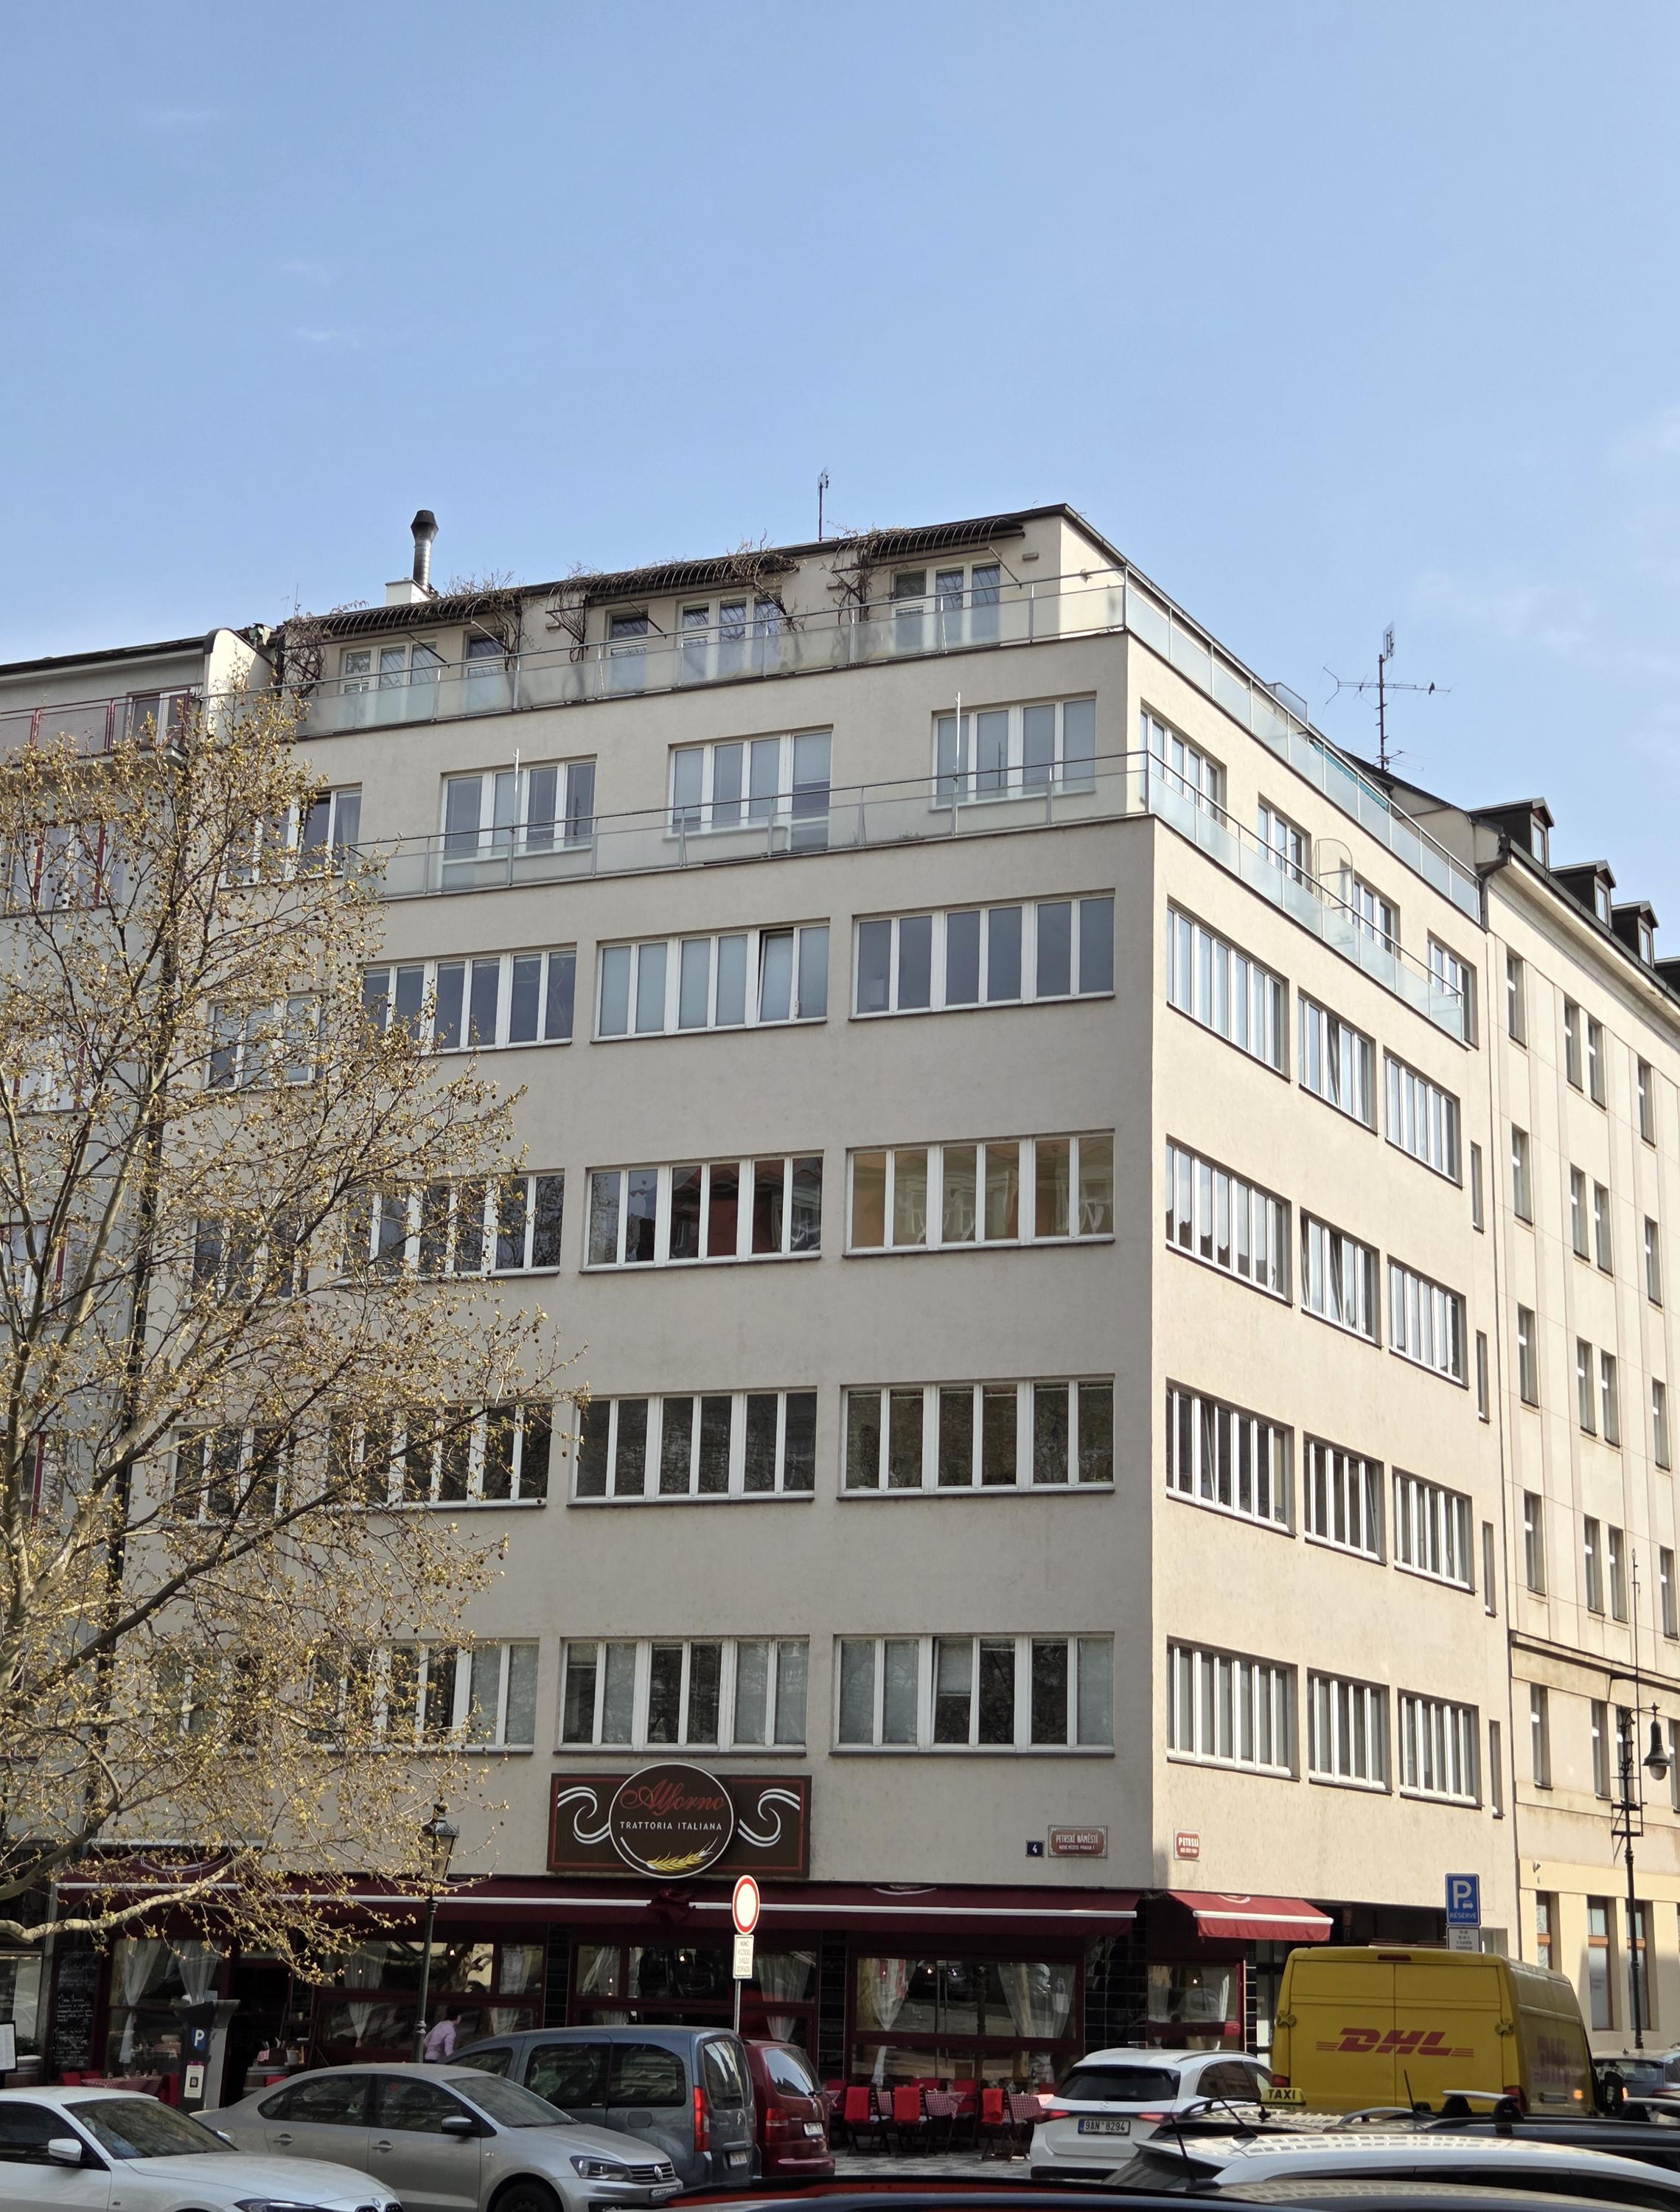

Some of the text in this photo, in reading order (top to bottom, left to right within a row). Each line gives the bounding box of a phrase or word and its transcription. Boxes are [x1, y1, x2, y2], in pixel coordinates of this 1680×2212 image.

[620, 1821, 722, 1830] TRATTORIA ITALIANA
[1032, 1844, 1038, 1853] 4
[1453, 1880, 1472, 1909] P
[195, 2029, 205, 2047] P
[1337, 2028, 1453, 2056] DHL
[1268, 2089, 1295, 2100] TAXI
[1085, 2121, 1125, 2131] 9AN 8294
